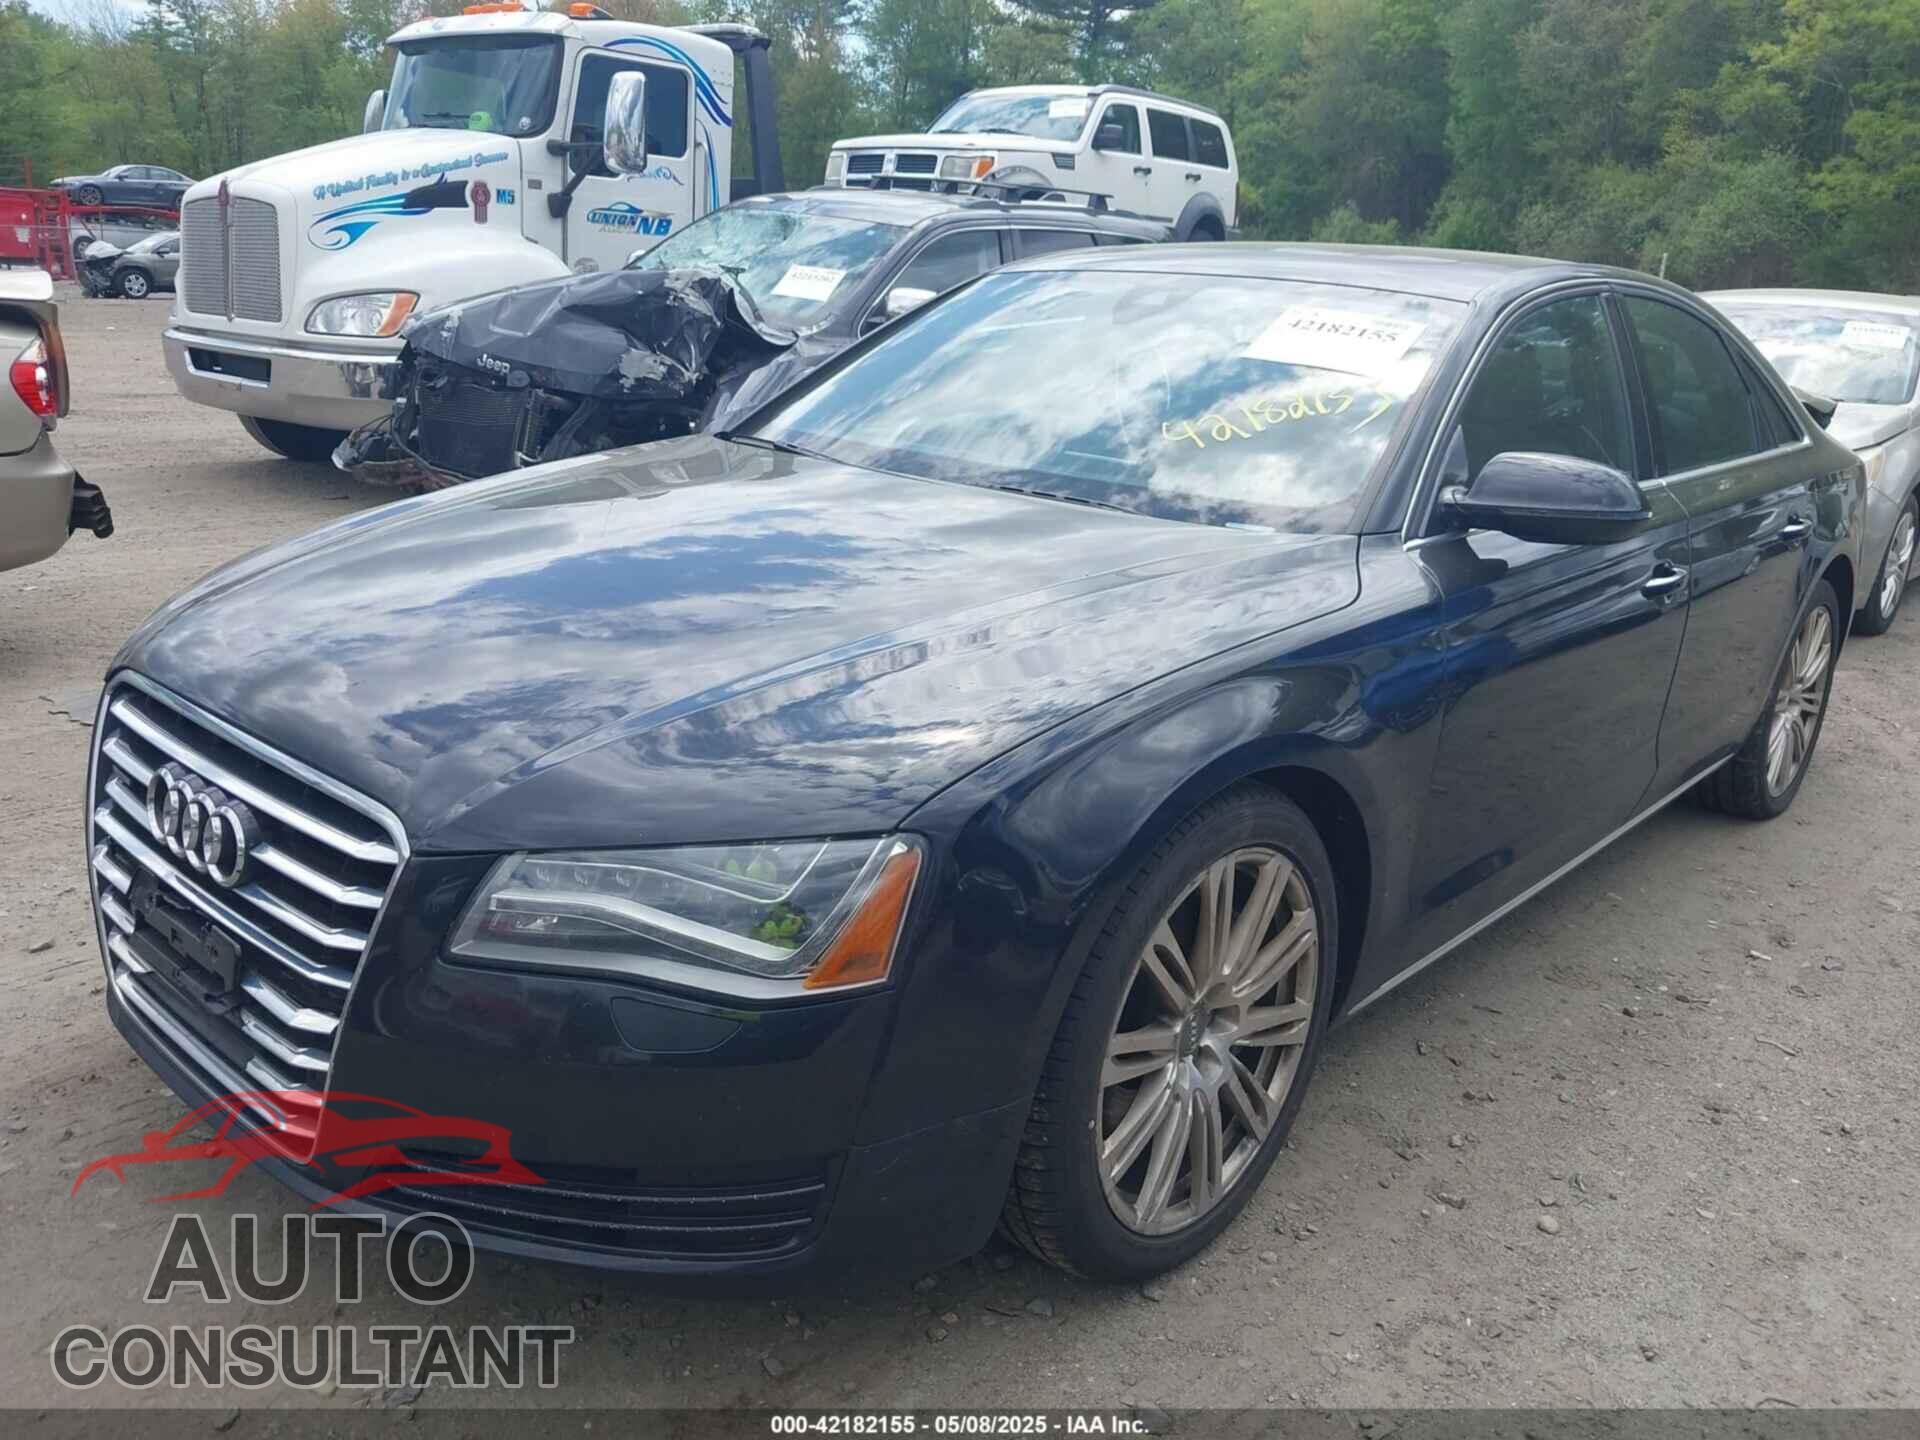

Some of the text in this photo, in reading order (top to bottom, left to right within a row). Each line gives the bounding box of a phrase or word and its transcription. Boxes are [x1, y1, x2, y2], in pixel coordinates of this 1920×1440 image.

[366, 171, 398, 190] Family
[1287, 318, 1398, 343] 42182155
[476, 353, 511, 376] Jeep
